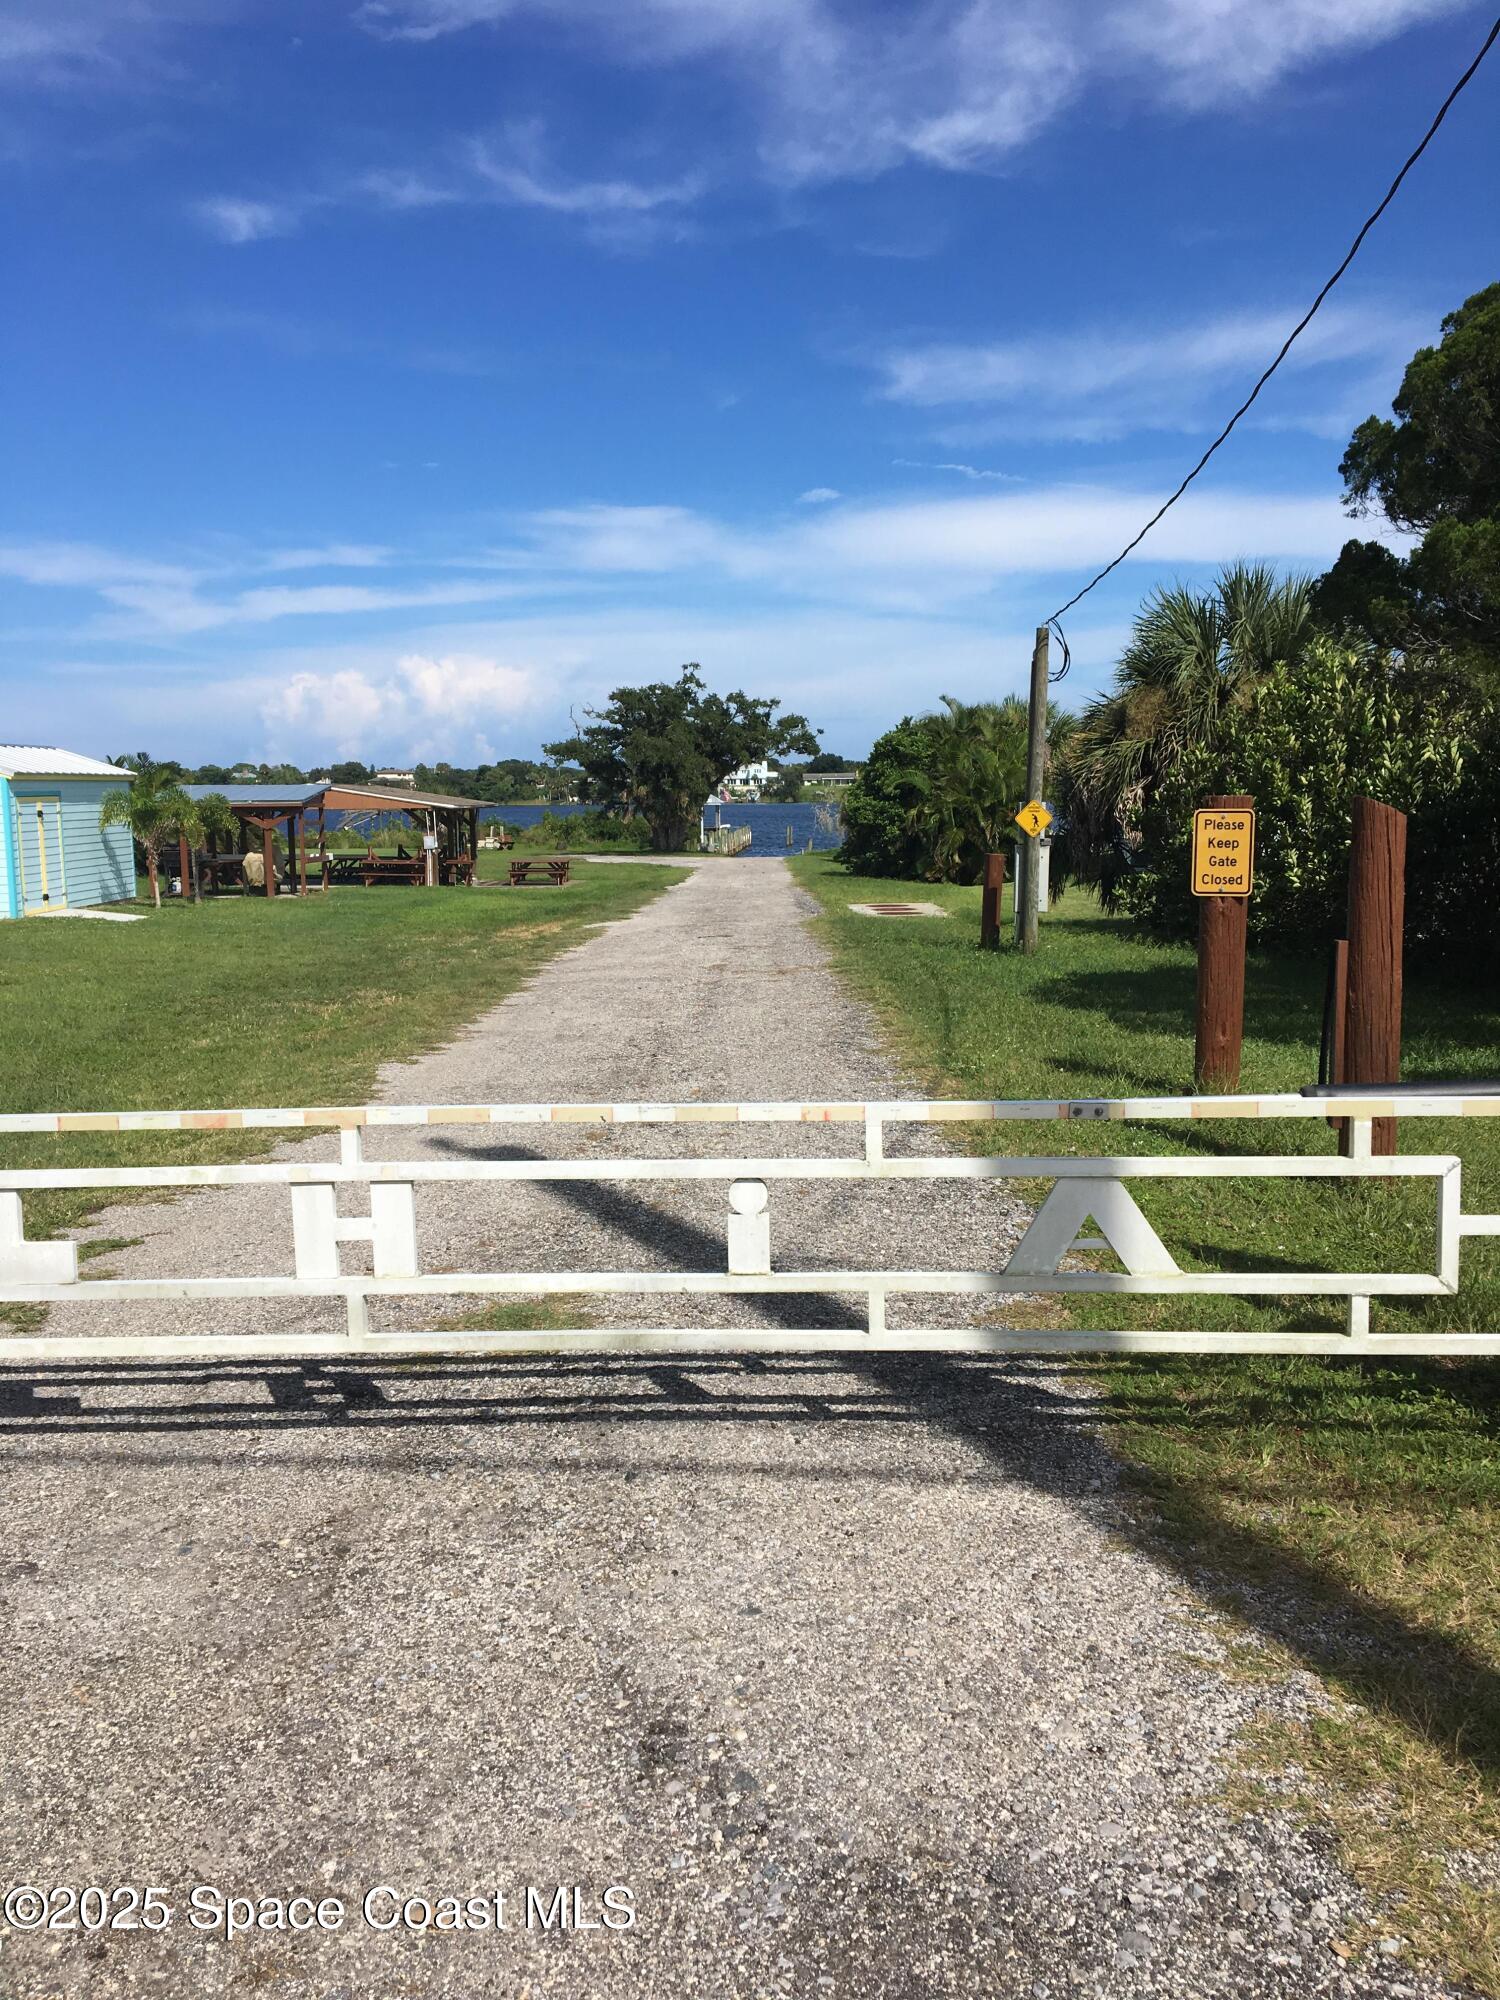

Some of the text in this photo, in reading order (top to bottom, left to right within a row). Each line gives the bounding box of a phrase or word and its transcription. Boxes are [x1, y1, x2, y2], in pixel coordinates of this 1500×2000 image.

[1204, 819, 1245, 830] Please
[1208, 837, 1240, 851] Keep
[1209, 856, 1237, 867] Gate
[1201, 874, 1243, 885] Closed
